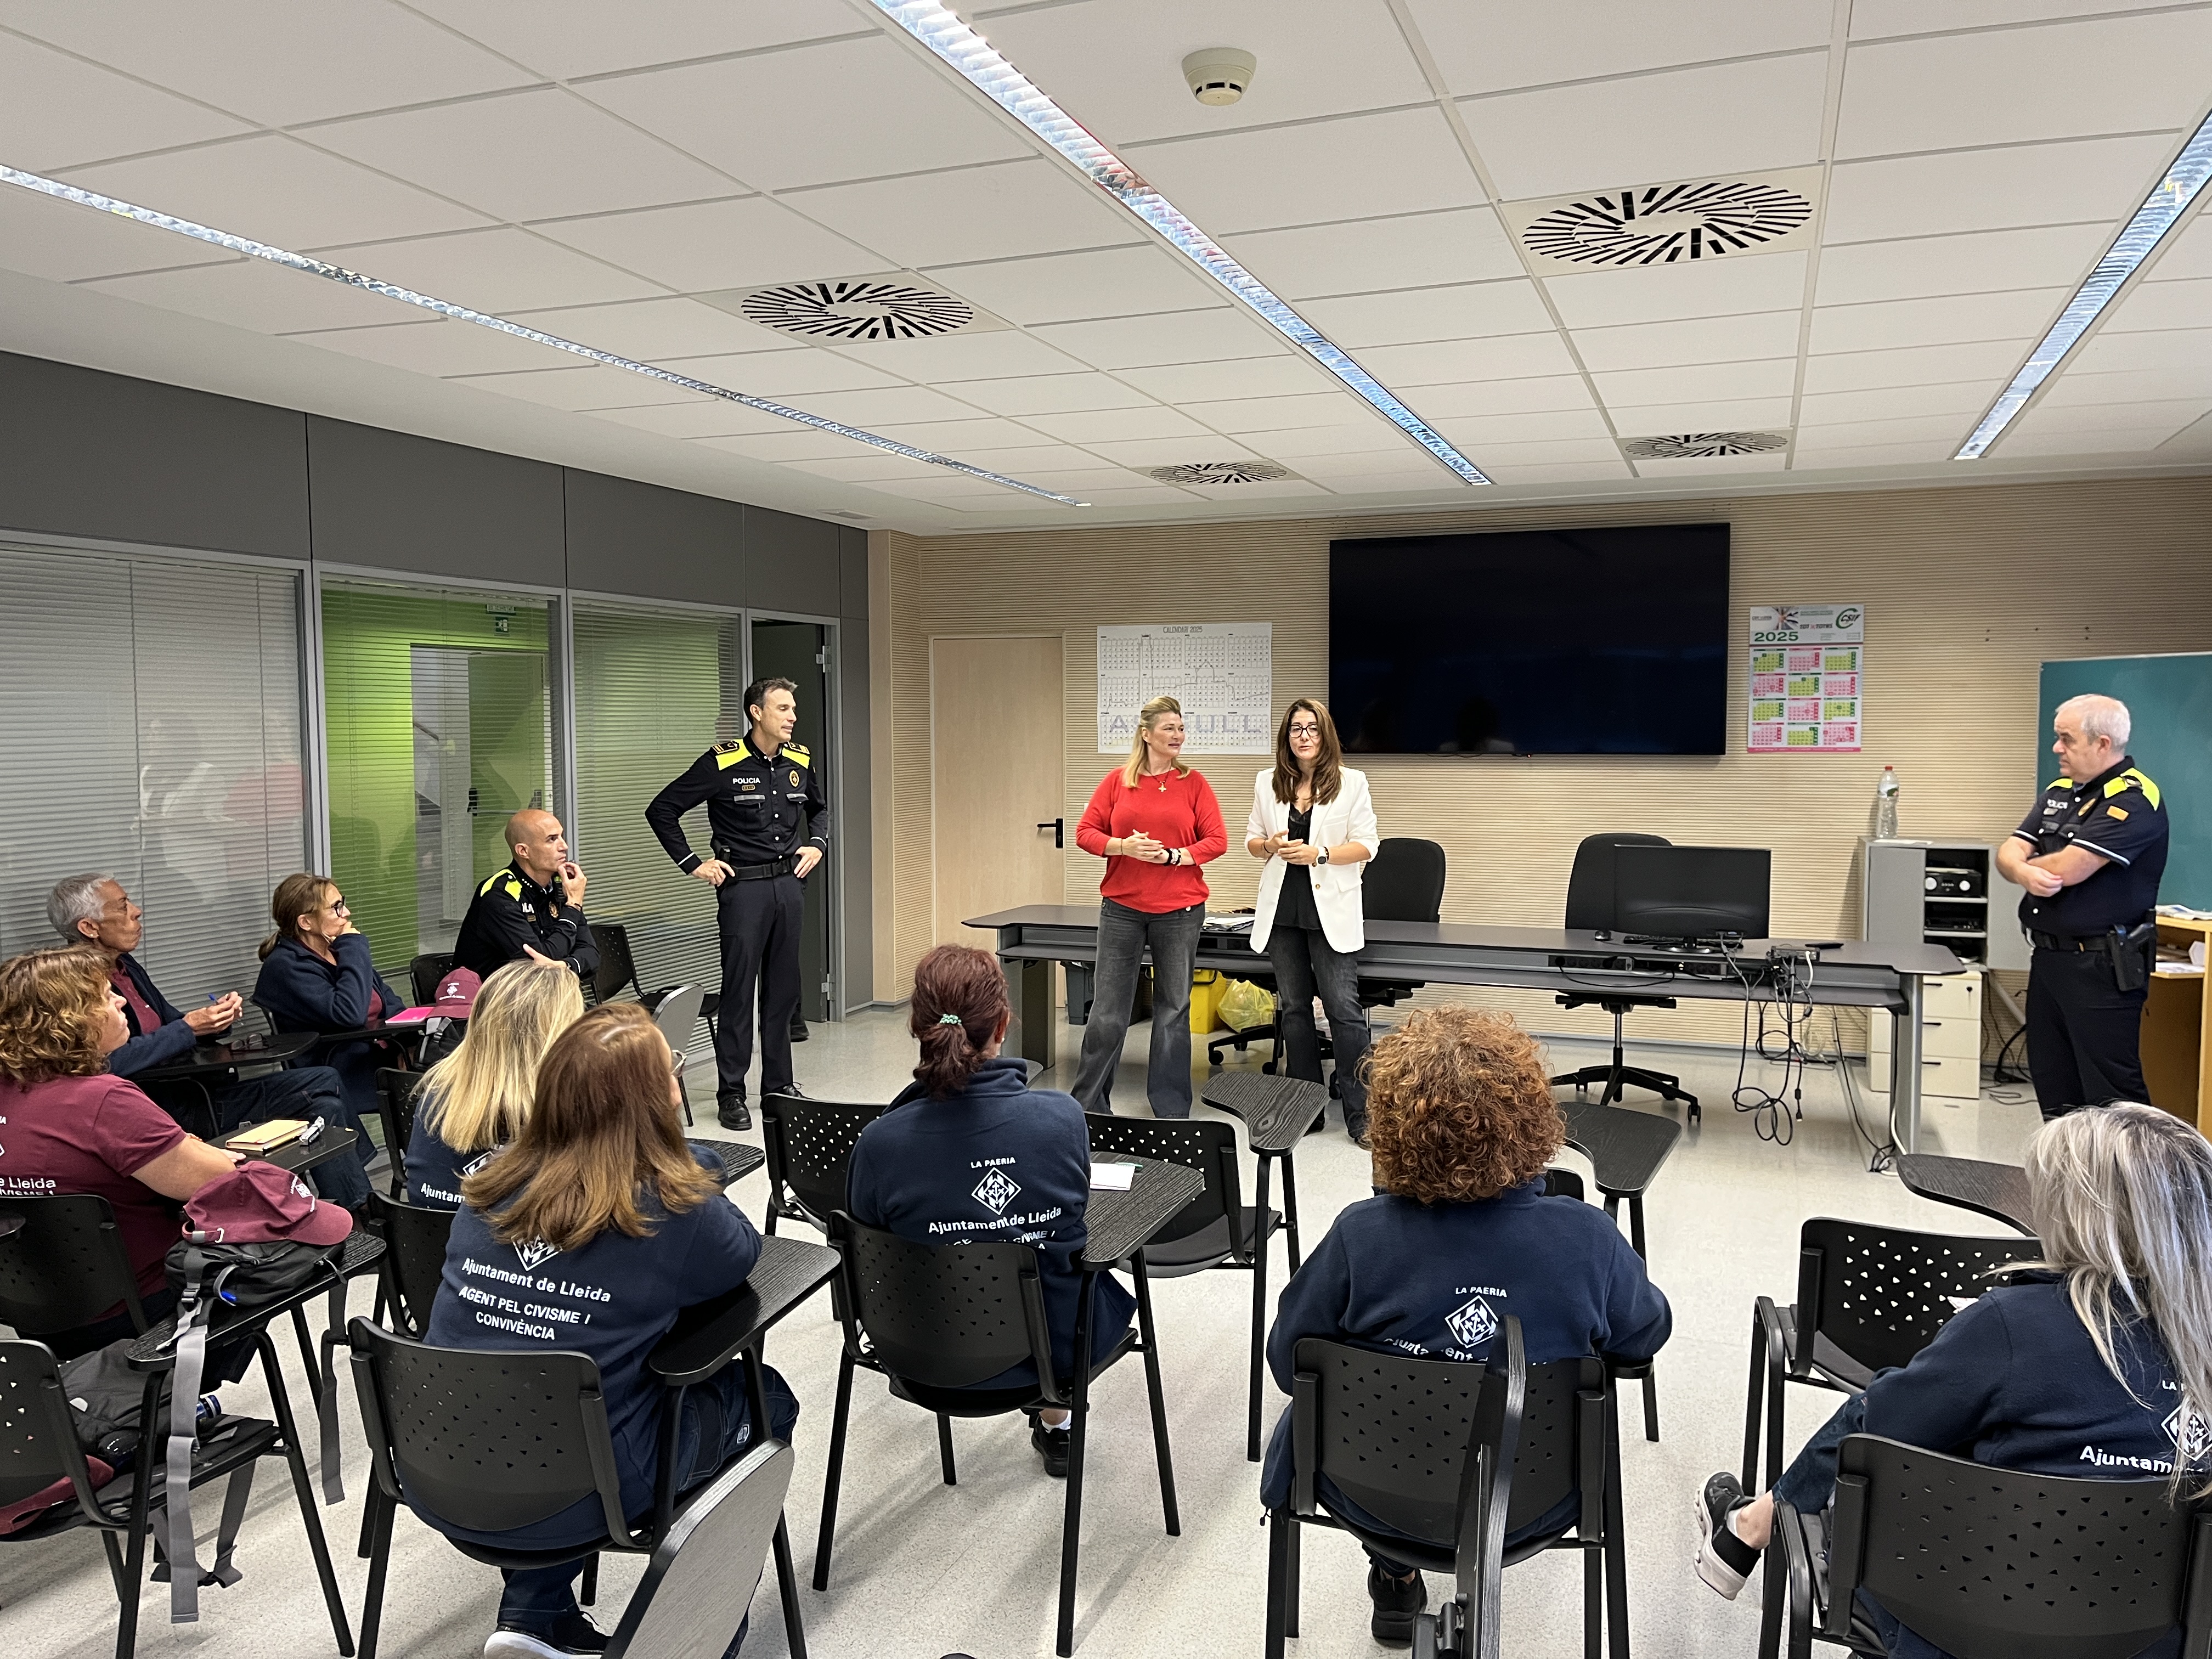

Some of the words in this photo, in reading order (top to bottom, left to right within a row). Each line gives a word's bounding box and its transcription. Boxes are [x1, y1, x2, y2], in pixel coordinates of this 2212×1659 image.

[1754, 631, 1798, 641] 2025
[984, 1157, 1015, 1167] PAERIA
[9, 1177, 56, 1189] Lleida
[421, 1183, 466, 1203] Ajuntam
[929, 1216, 1010, 1234] Ajuntament
[1009, 1214, 1025, 1226] de
[1029, 1207, 1061, 1223] Lleida
[462, 1258, 533, 1288] Ajuntament
[536, 1277, 556, 1293] de
[560, 1281, 611, 1302] Lleida
[1470, 1286, 1507, 1297] PAERIA
[459, 1286, 496, 1307] AGENT
[498, 1297, 521, 1313] PEL
[524, 1304, 581, 1324] CIVISME
[476, 1311, 555, 1340] CONVIVÈNCIA
[2162, 1380, 2177, 1391] LA
[2079, 1445, 2173, 1474] Ajuntam
